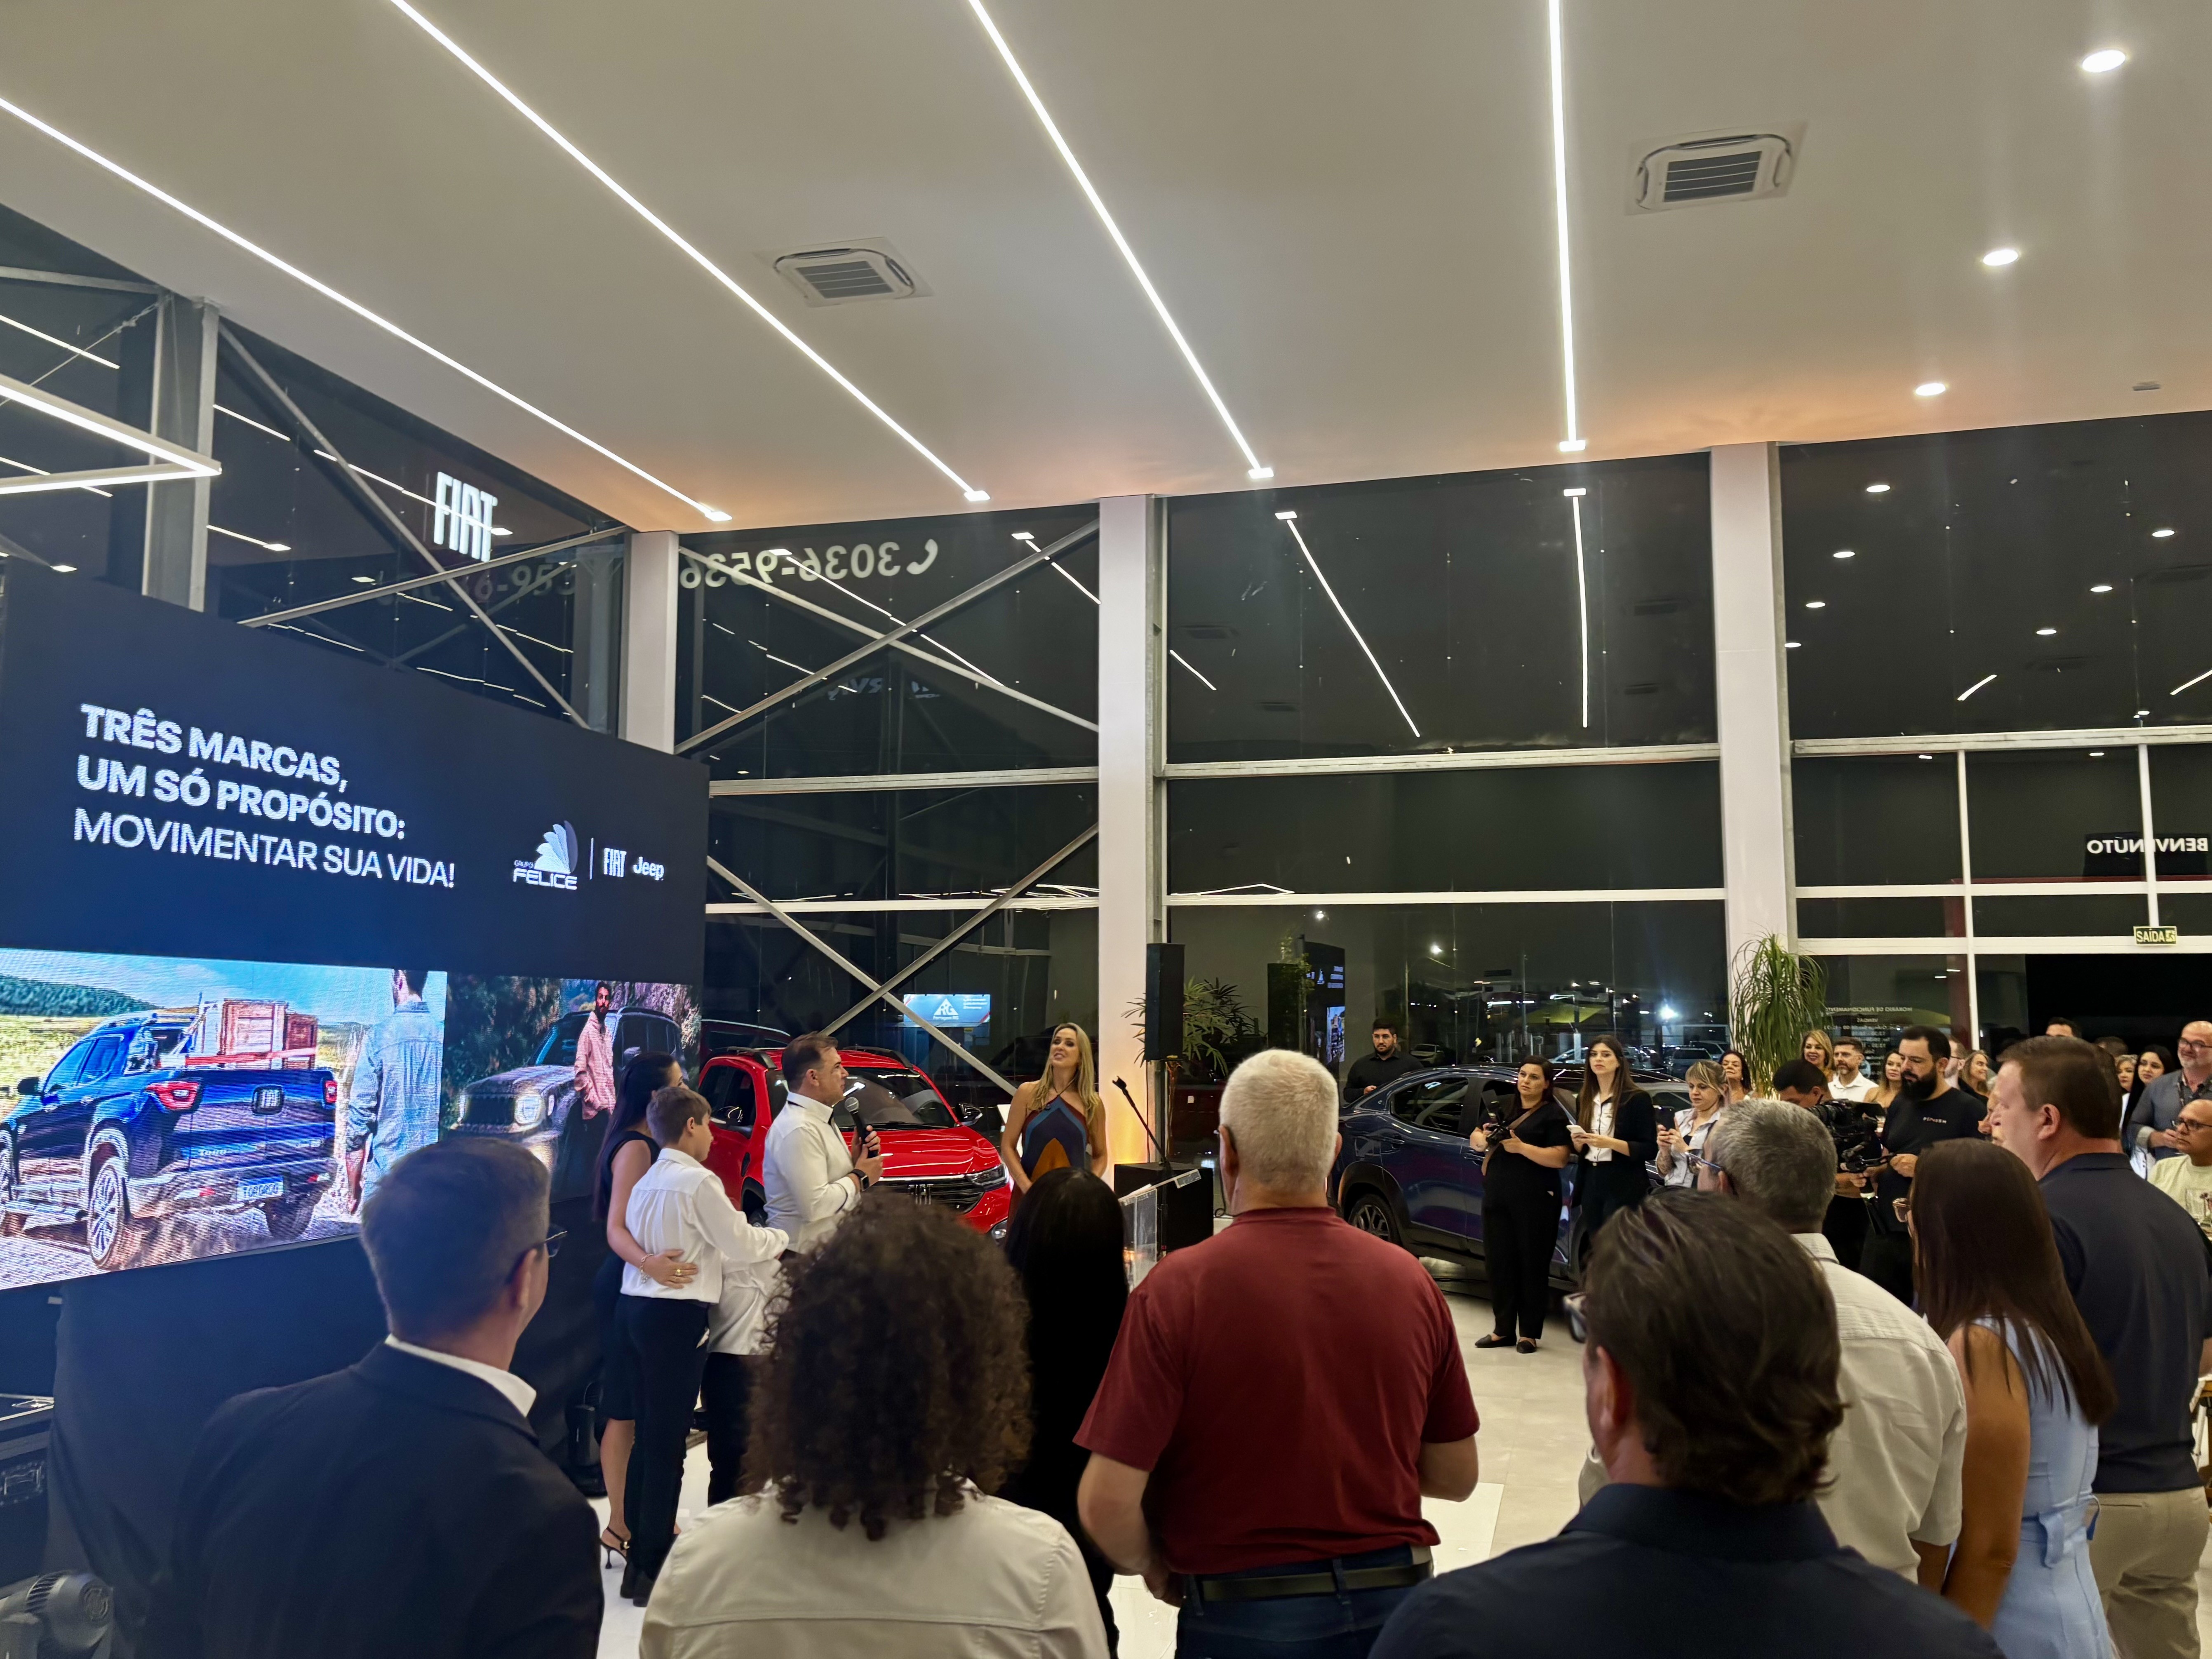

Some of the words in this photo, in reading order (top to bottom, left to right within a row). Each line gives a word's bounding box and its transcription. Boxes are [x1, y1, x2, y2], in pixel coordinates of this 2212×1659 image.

[434, 471, 498, 562] FIAT
[80, 703, 182, 754] TRÊS
[189, 727, 348, 793] MARCAS,
[77, 755, 146, 797] UM
[153, 768, 211, 806] SÓ
[216, 780, 405, 840] PROPÓSITO:
[74, 808, 317, 870] MOVIMENTAR
[323, 845, 382, 878] SUA
[387, 853, 454, 888] VIDA!
[604, 848, 627, 878] FIAT
[633, 856, 664, 881] Jeep
[513, 868, 577, 890] FELICE
[2136, 928, 2165, 942] SAÍDA
